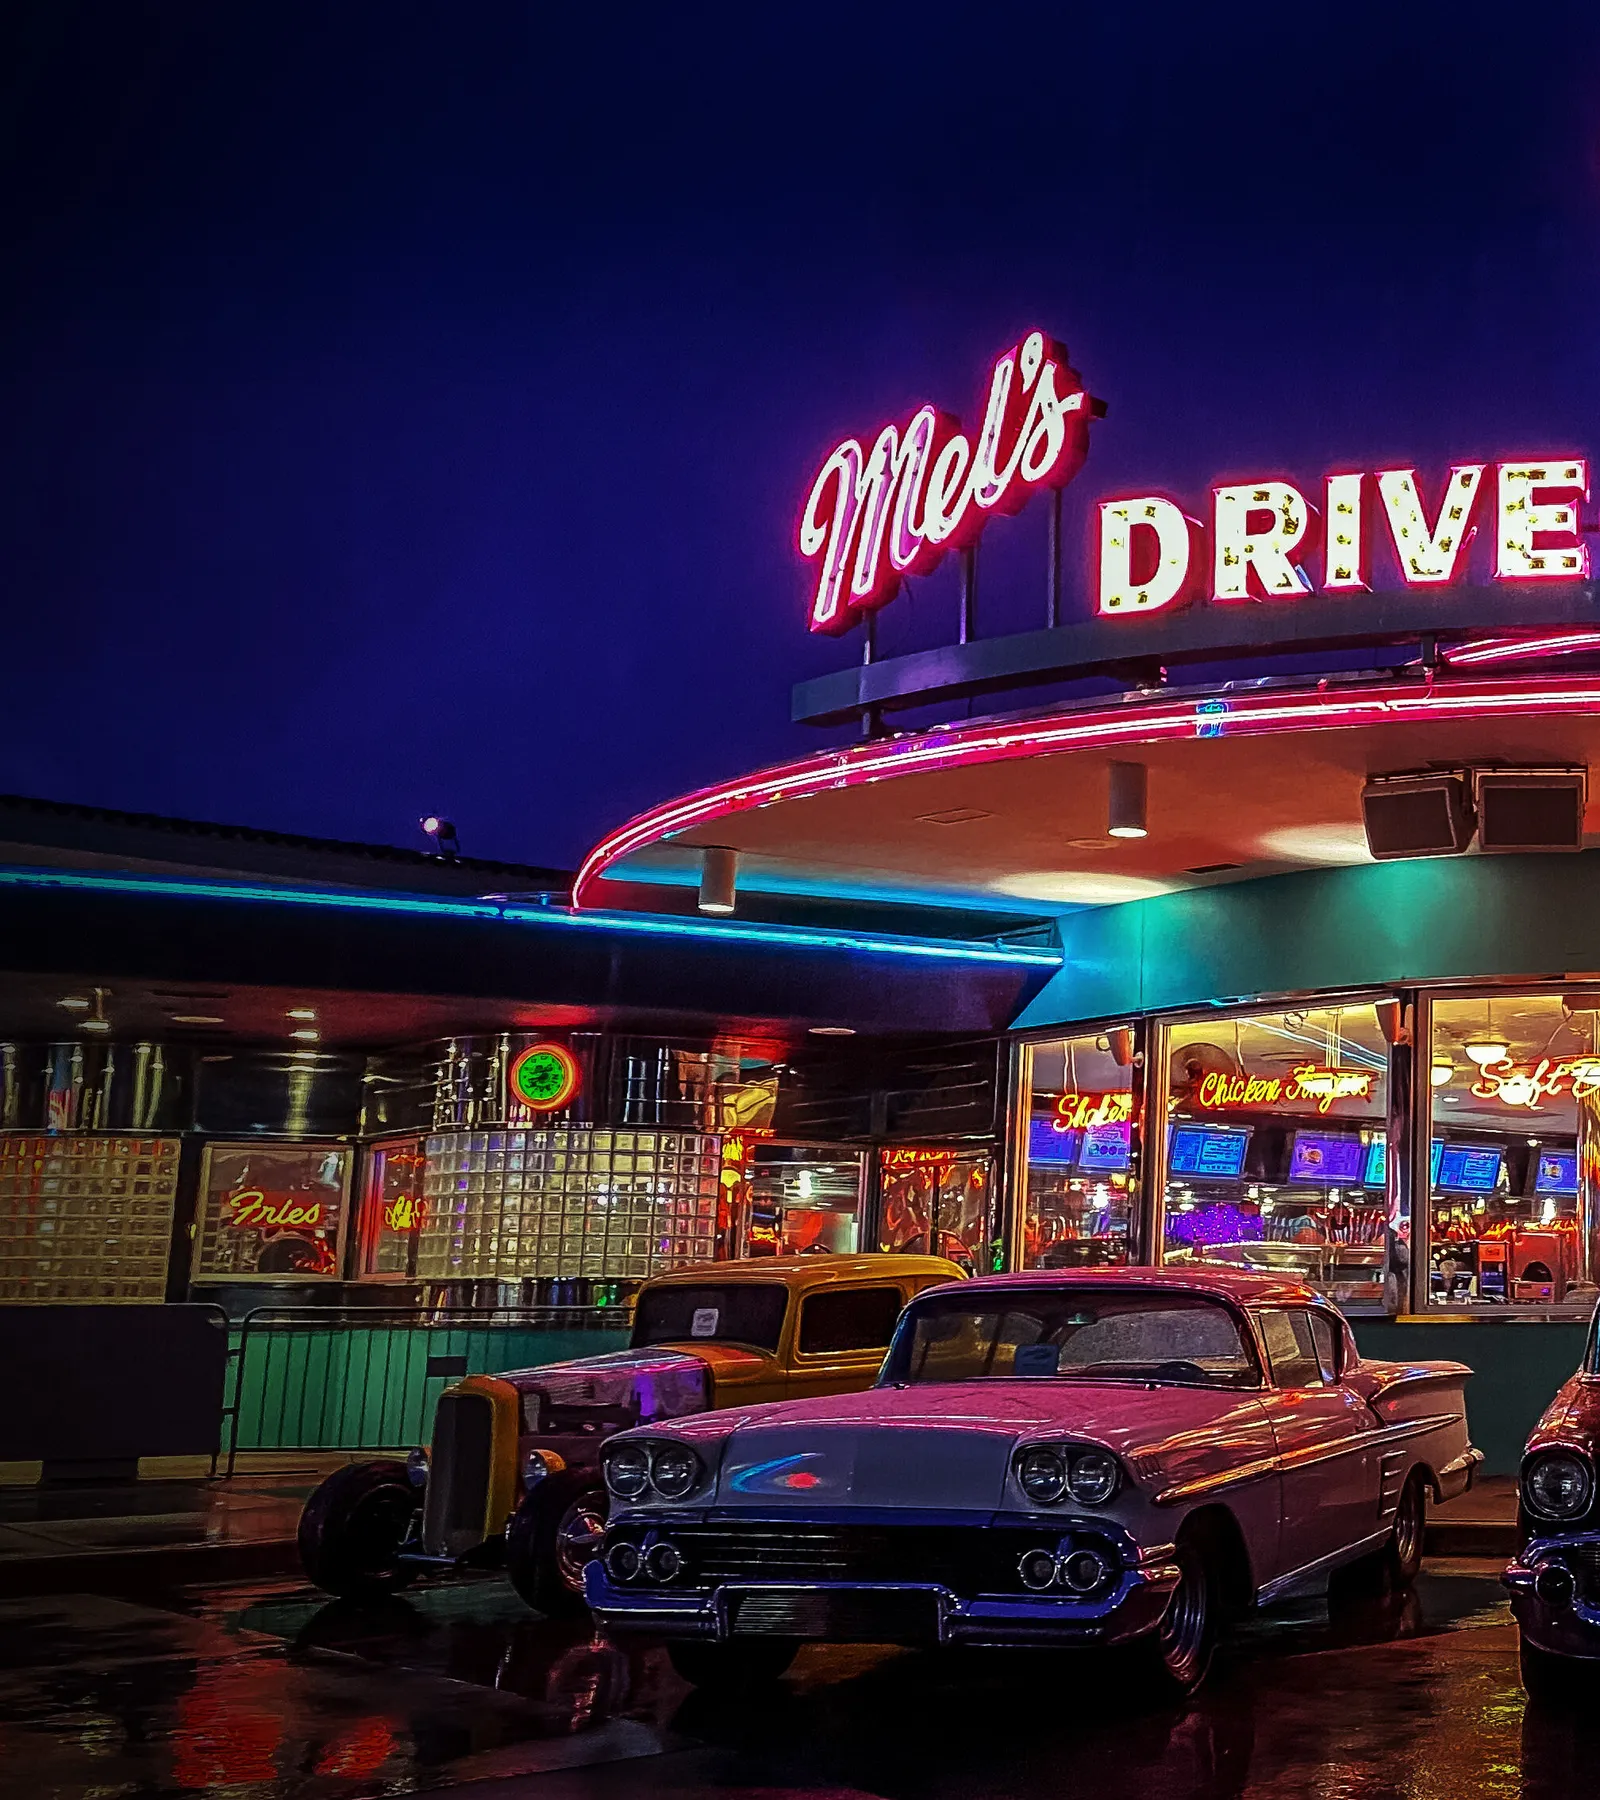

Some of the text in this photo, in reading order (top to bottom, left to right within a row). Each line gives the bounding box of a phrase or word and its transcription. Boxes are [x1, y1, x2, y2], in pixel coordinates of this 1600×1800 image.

[800, 332, 1085, 630] Mel's
[1199, 1072, 1282, 1107] Chicken
[1052, 1093, 1132, 1133] Shakes
[229, 1191, 320, 1225] Fries
